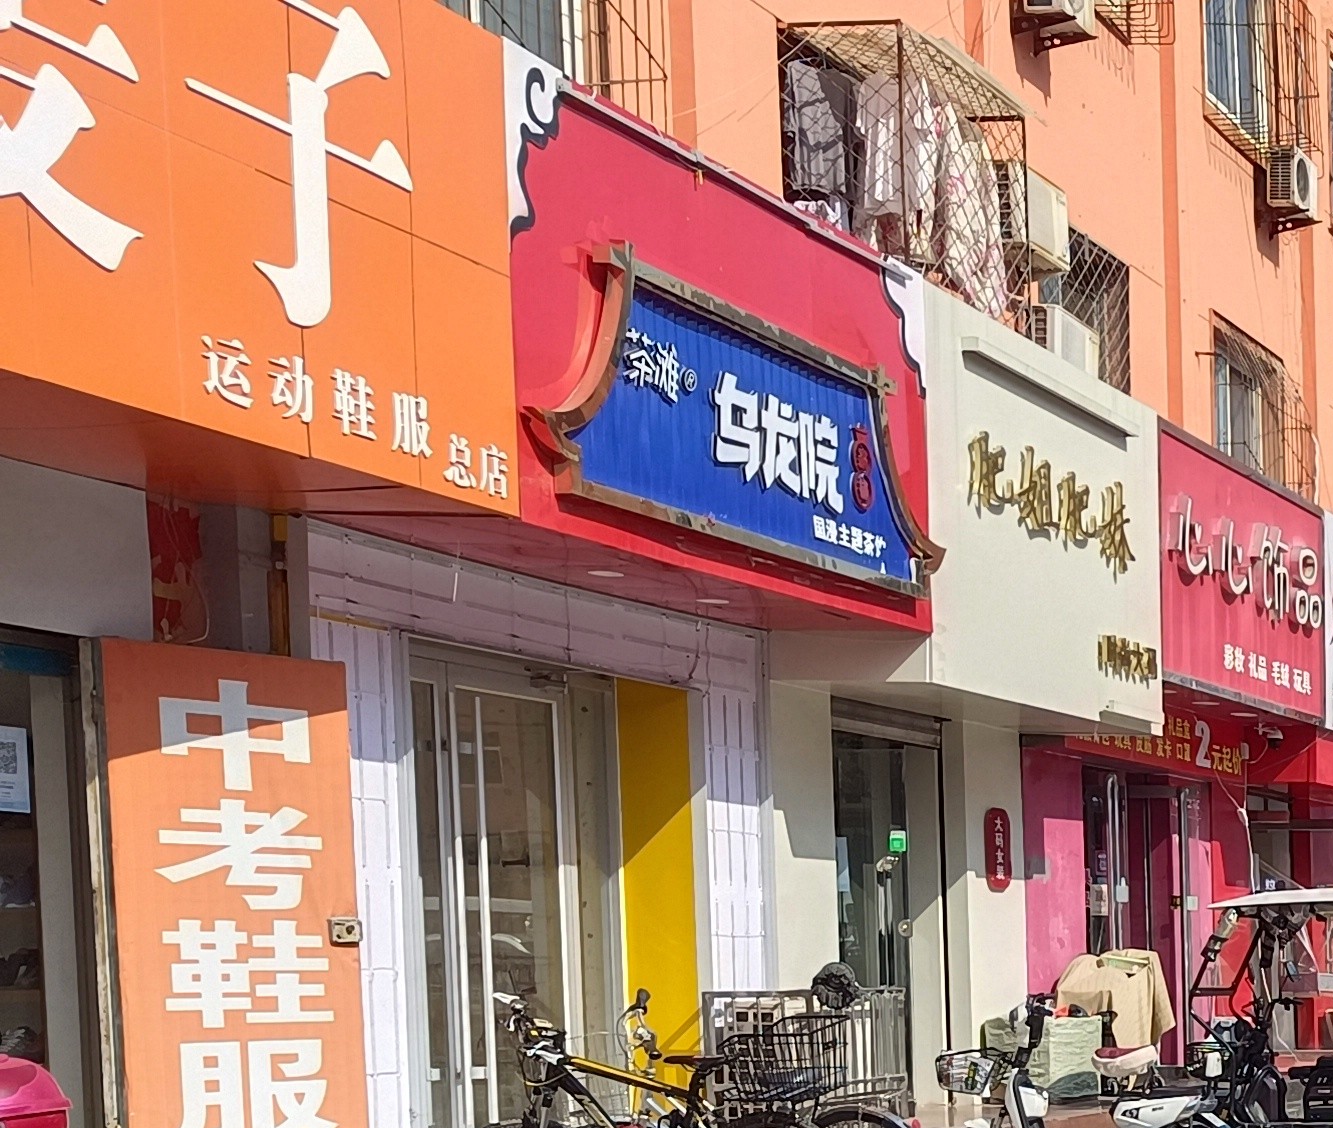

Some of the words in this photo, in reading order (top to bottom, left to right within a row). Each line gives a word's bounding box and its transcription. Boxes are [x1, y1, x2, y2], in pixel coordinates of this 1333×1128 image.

[201, 334, 433, 459] 运动鞋服
[443, 432, 510, 500] 总店
[712, 370, 844, 515] 乌龙院
[1168, 496, 1323, 630] 心心饰品
[1247, 651, 1268, 682] 礼品
[1292, 667, 1313, 696] 玩具
[1194, 720, 1212, 769] 2
